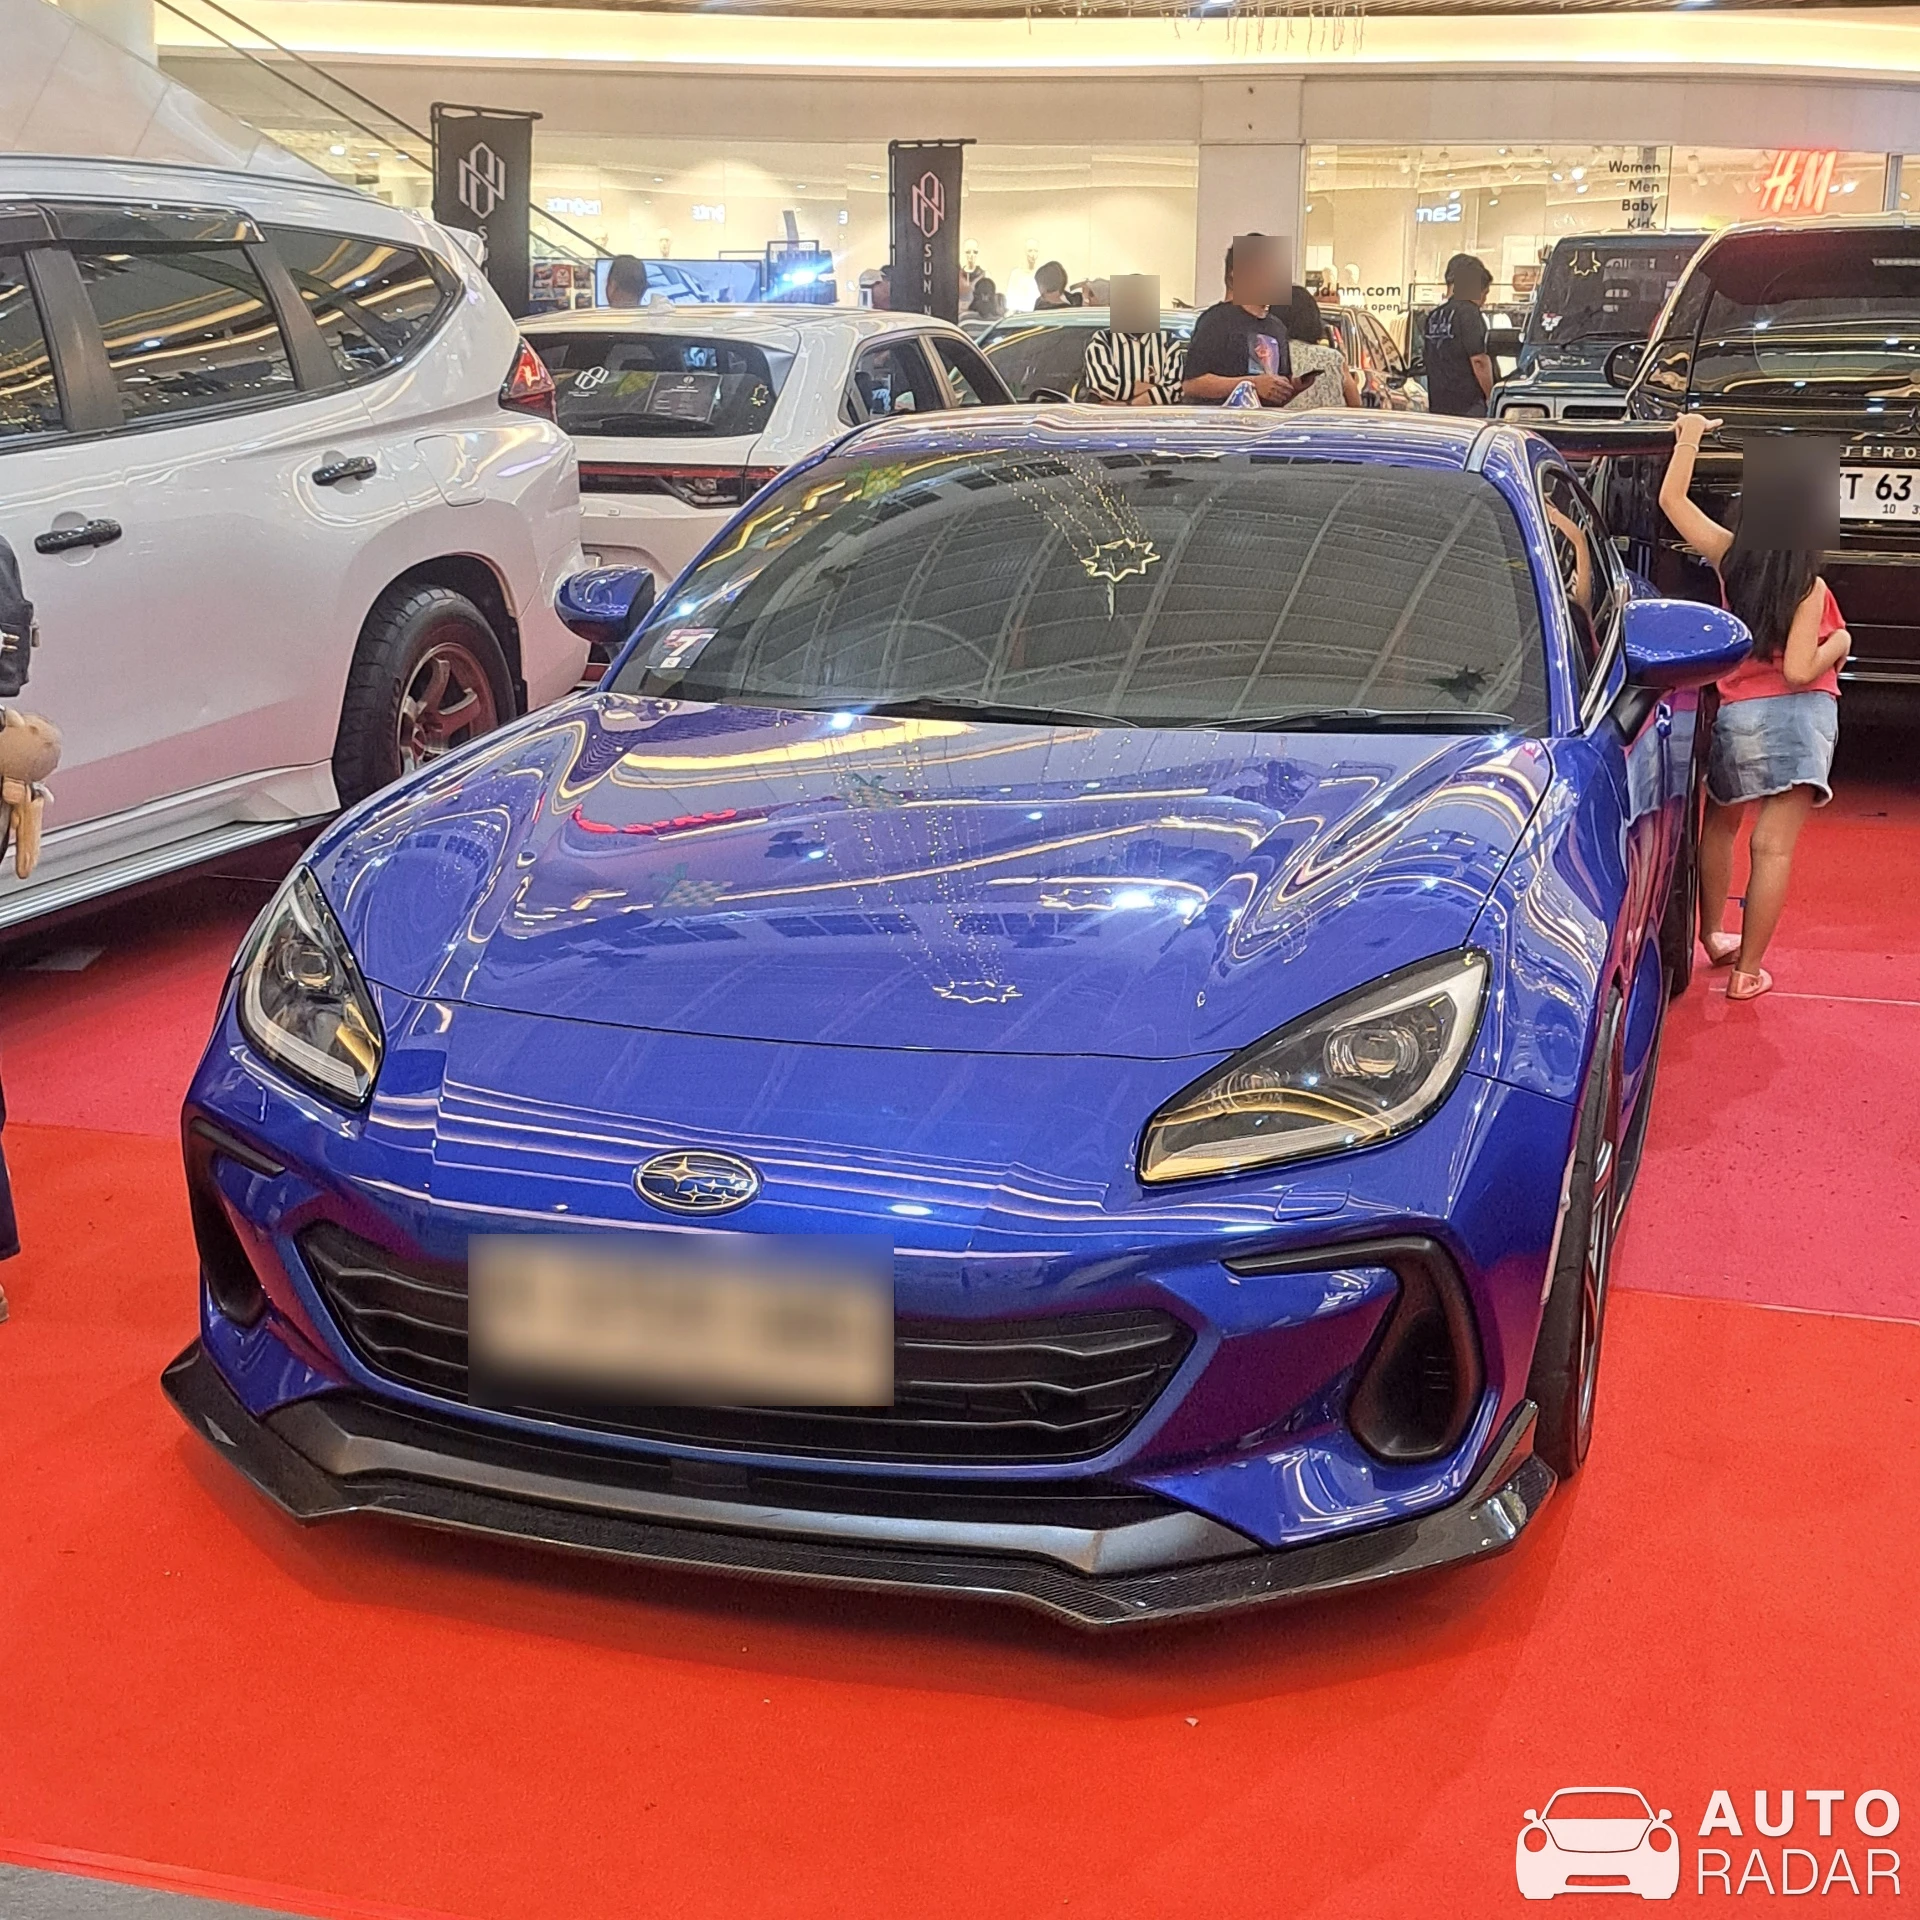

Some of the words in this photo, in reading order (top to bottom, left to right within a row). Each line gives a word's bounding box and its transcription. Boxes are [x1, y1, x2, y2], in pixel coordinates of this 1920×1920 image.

[1608, 160, 1661, 174] Women
[1628, 180, 1660, 193] Men
[1758, 150, 1837, 213] H&M
[1621, 199, 1658, 216] Baby
[1627, 217, 1657, 230] Kids
[1371, 303, 1400, 314] open
[1876, 474, 1912, 501] 63
